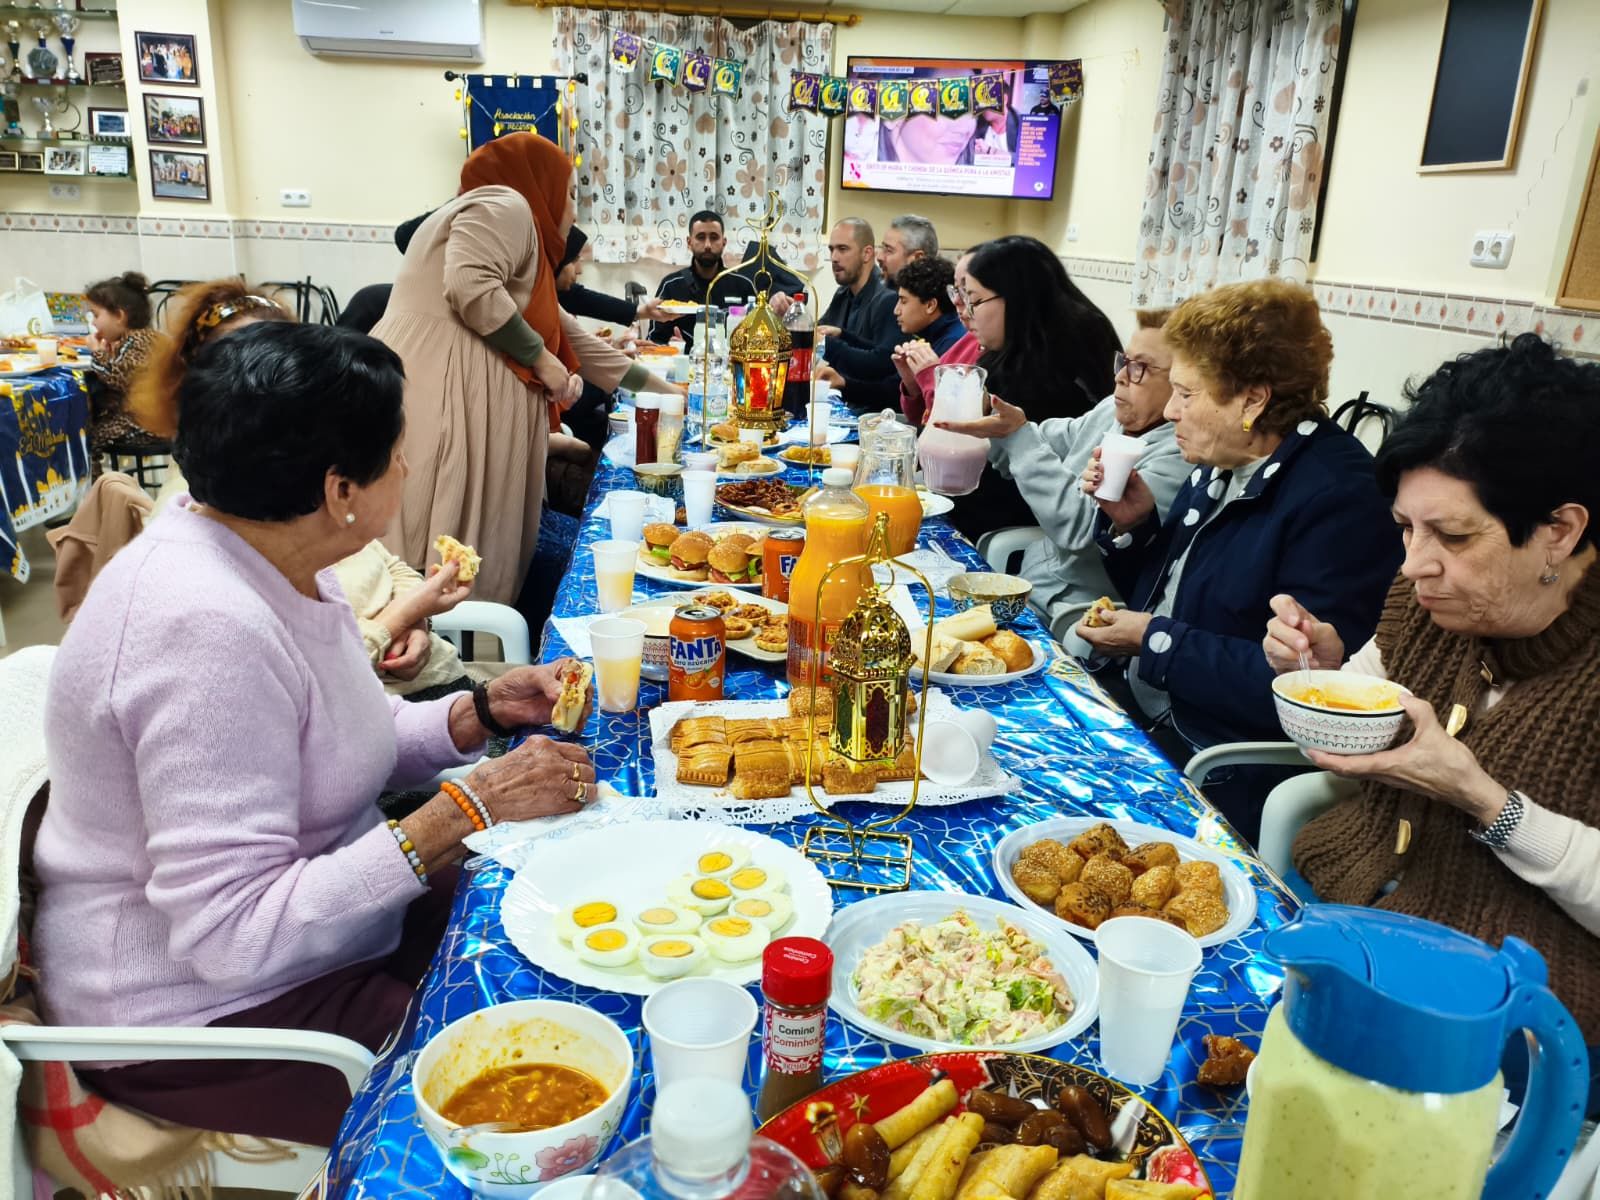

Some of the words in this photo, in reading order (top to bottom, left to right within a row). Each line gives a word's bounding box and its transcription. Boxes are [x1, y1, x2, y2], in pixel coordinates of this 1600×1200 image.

[670, 635, 722, 661] FANTA
[778, 1024, 815, 1035] Comino
[773, 1034, 819, 1048] Cominhos
